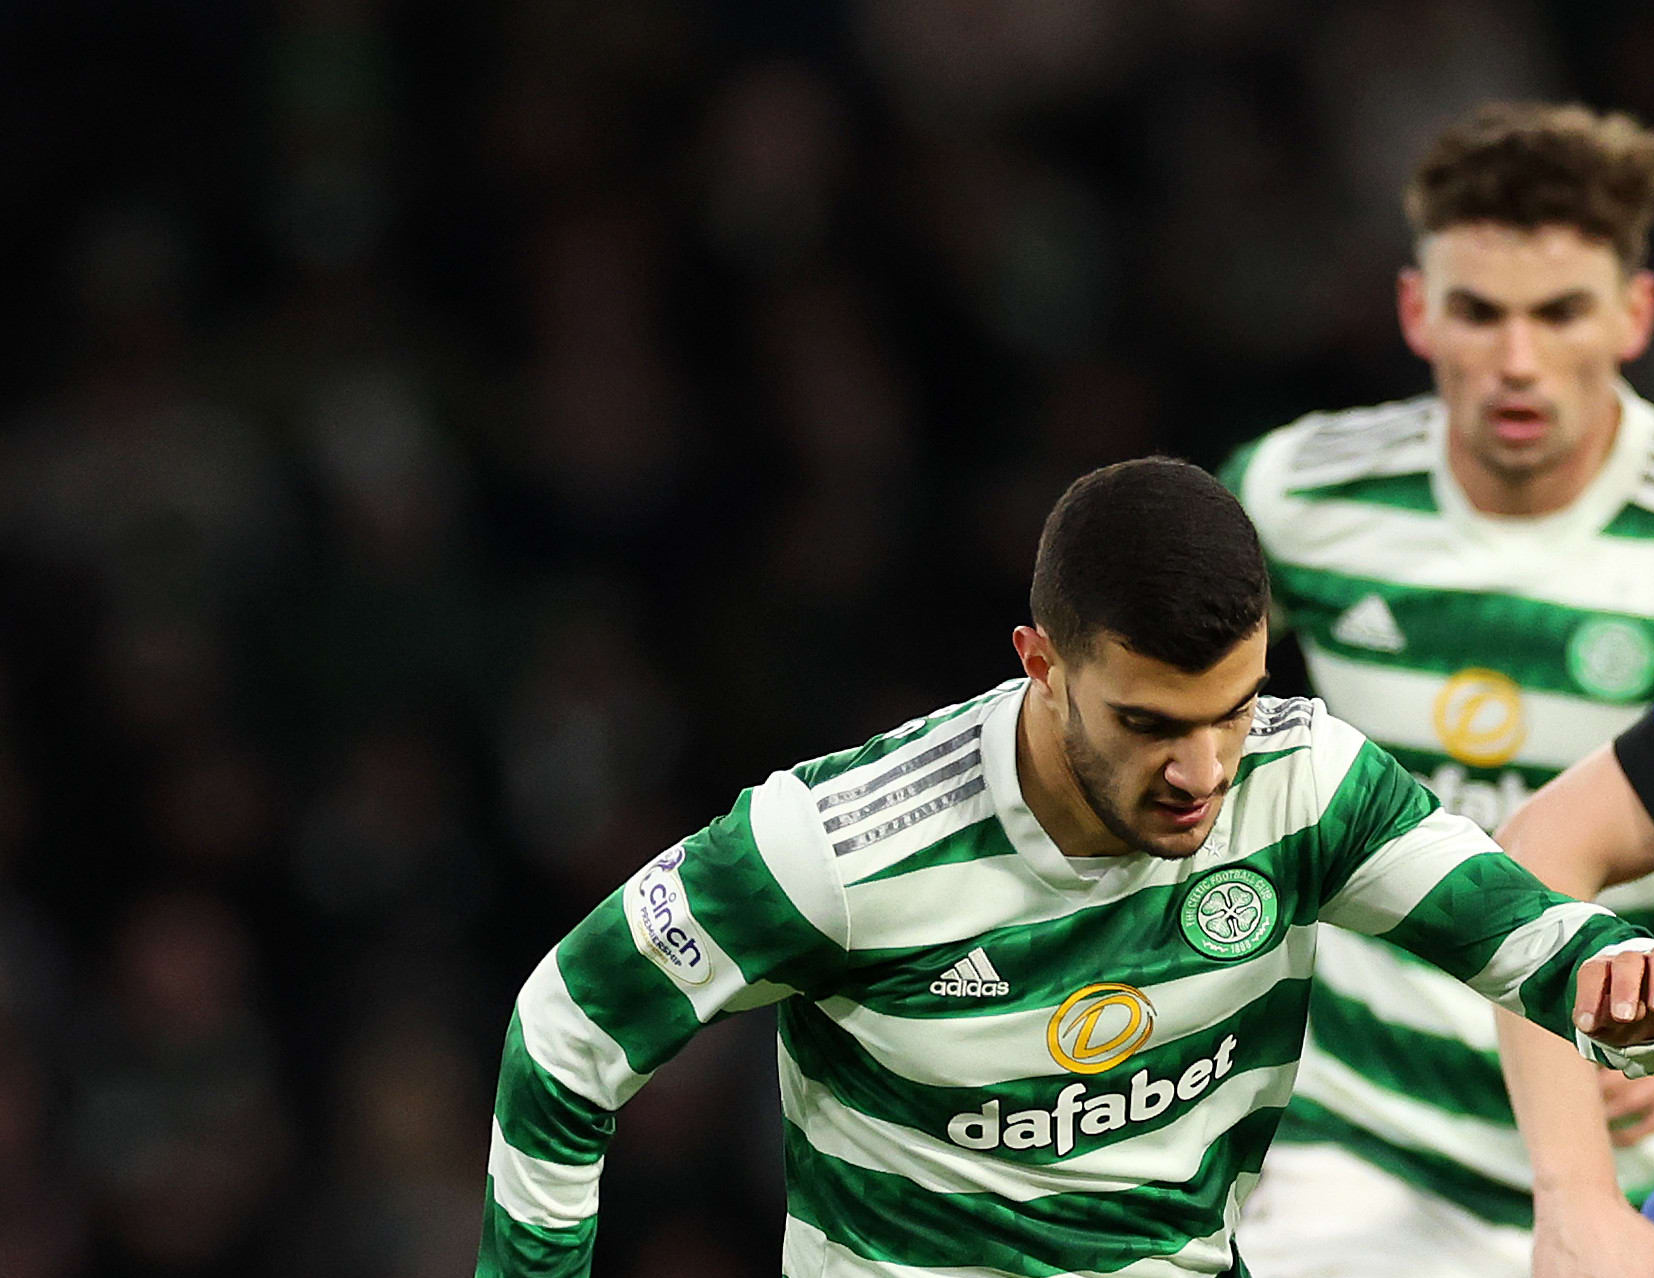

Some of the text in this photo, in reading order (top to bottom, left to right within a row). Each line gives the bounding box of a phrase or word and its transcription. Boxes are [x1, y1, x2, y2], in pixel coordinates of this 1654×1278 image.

[1210, 870, 1256, 886] FOOTBALL
[640, 906, 683, 968] PREMIERSHIP
[649, 883, 702, 968] cinch
[929, 979, 1010, 998] adidas
[946, 1033, 1238, 1156] dafabet
